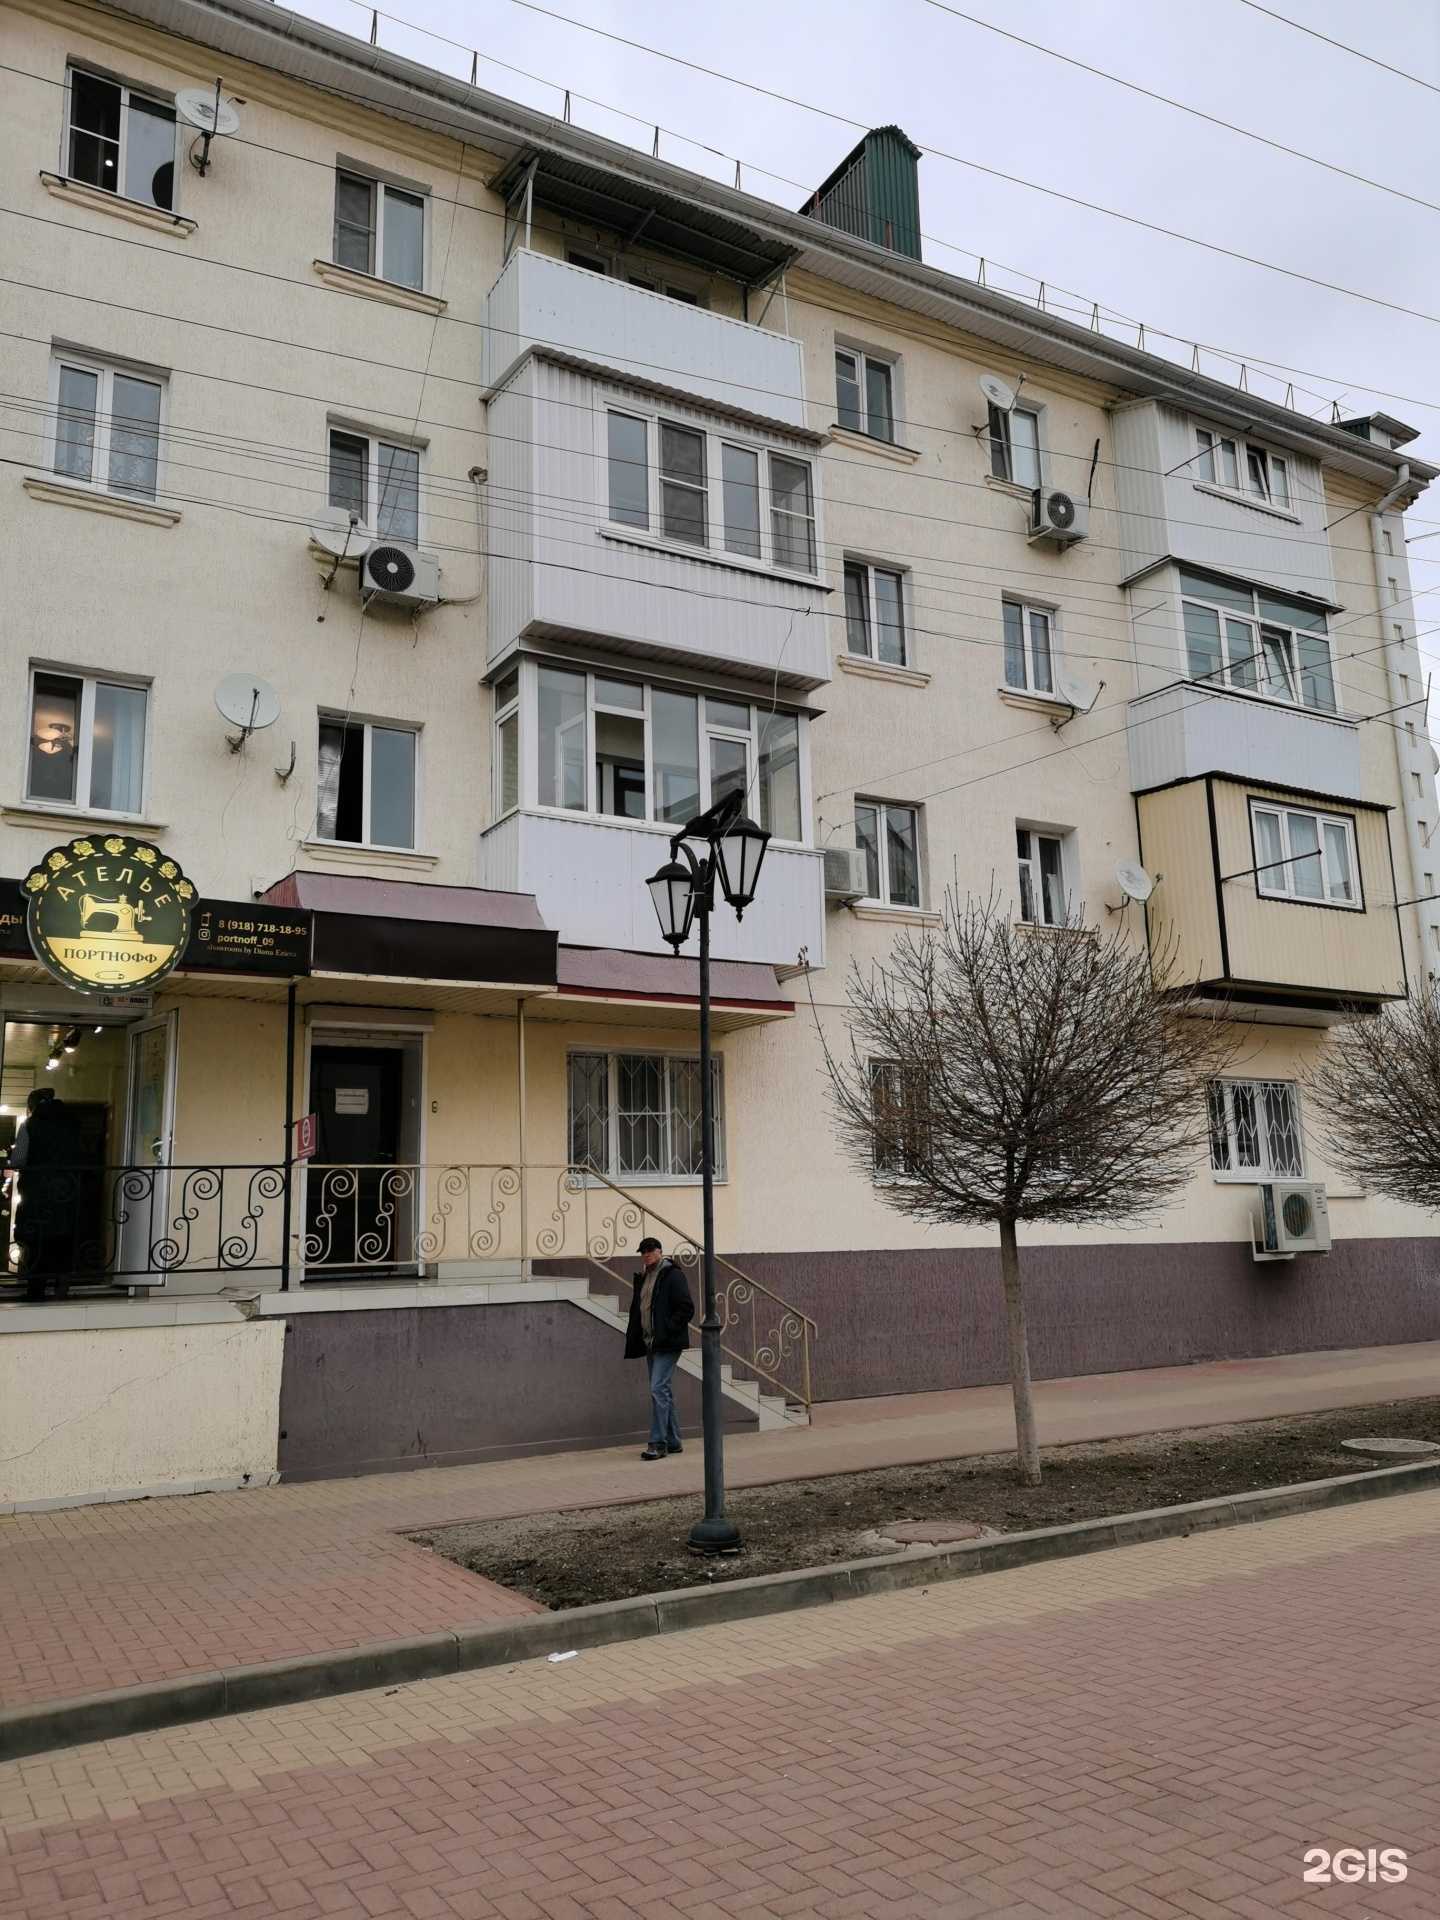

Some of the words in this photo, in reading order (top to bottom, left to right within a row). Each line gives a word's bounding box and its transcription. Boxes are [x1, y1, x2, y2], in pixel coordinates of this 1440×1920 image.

[57, 866, 171, 908] АТЕЛЬЕ
[218, 919, 225, 929] 8
[227, 919, 255, 932] (918)
[257, 923, 307, 936] 718-18-95
[217, 934, 275, 947] portnoff_09
[64, 948, 158, 963] ПОРТНОФФ
